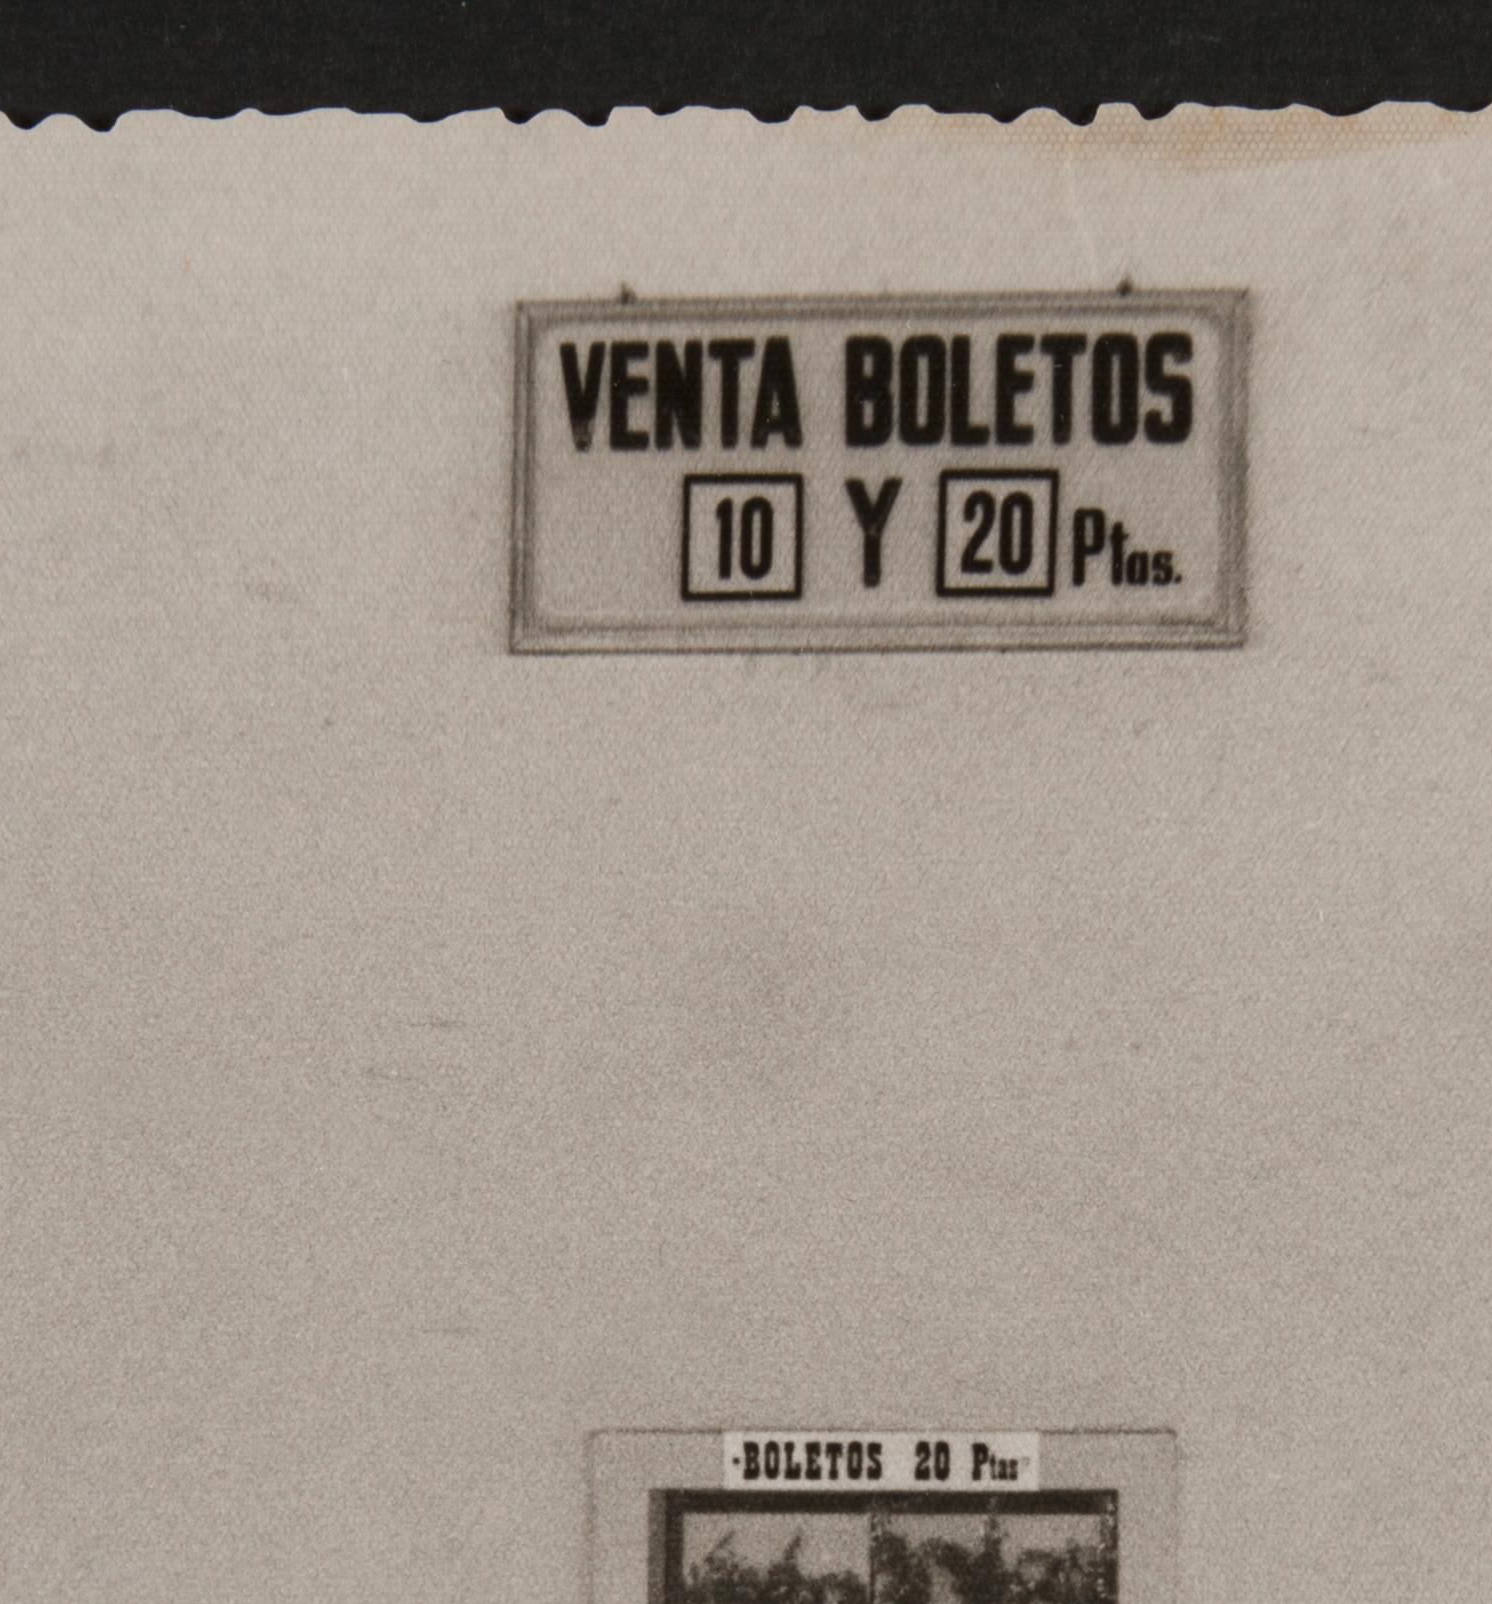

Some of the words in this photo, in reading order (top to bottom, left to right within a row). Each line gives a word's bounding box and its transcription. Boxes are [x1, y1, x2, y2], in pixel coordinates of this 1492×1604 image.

[560, 336, 803, 452] VENTA
[845, 331, 1195, 448] BOLETOS
[714, 495, 775, 580] 10
[844, 477, 904, 588] Y
[960, 489, 1036, 576] 20
[1071, 506, 1184, 587] Ptas.
[914, 1440, 951, 1481] 20
